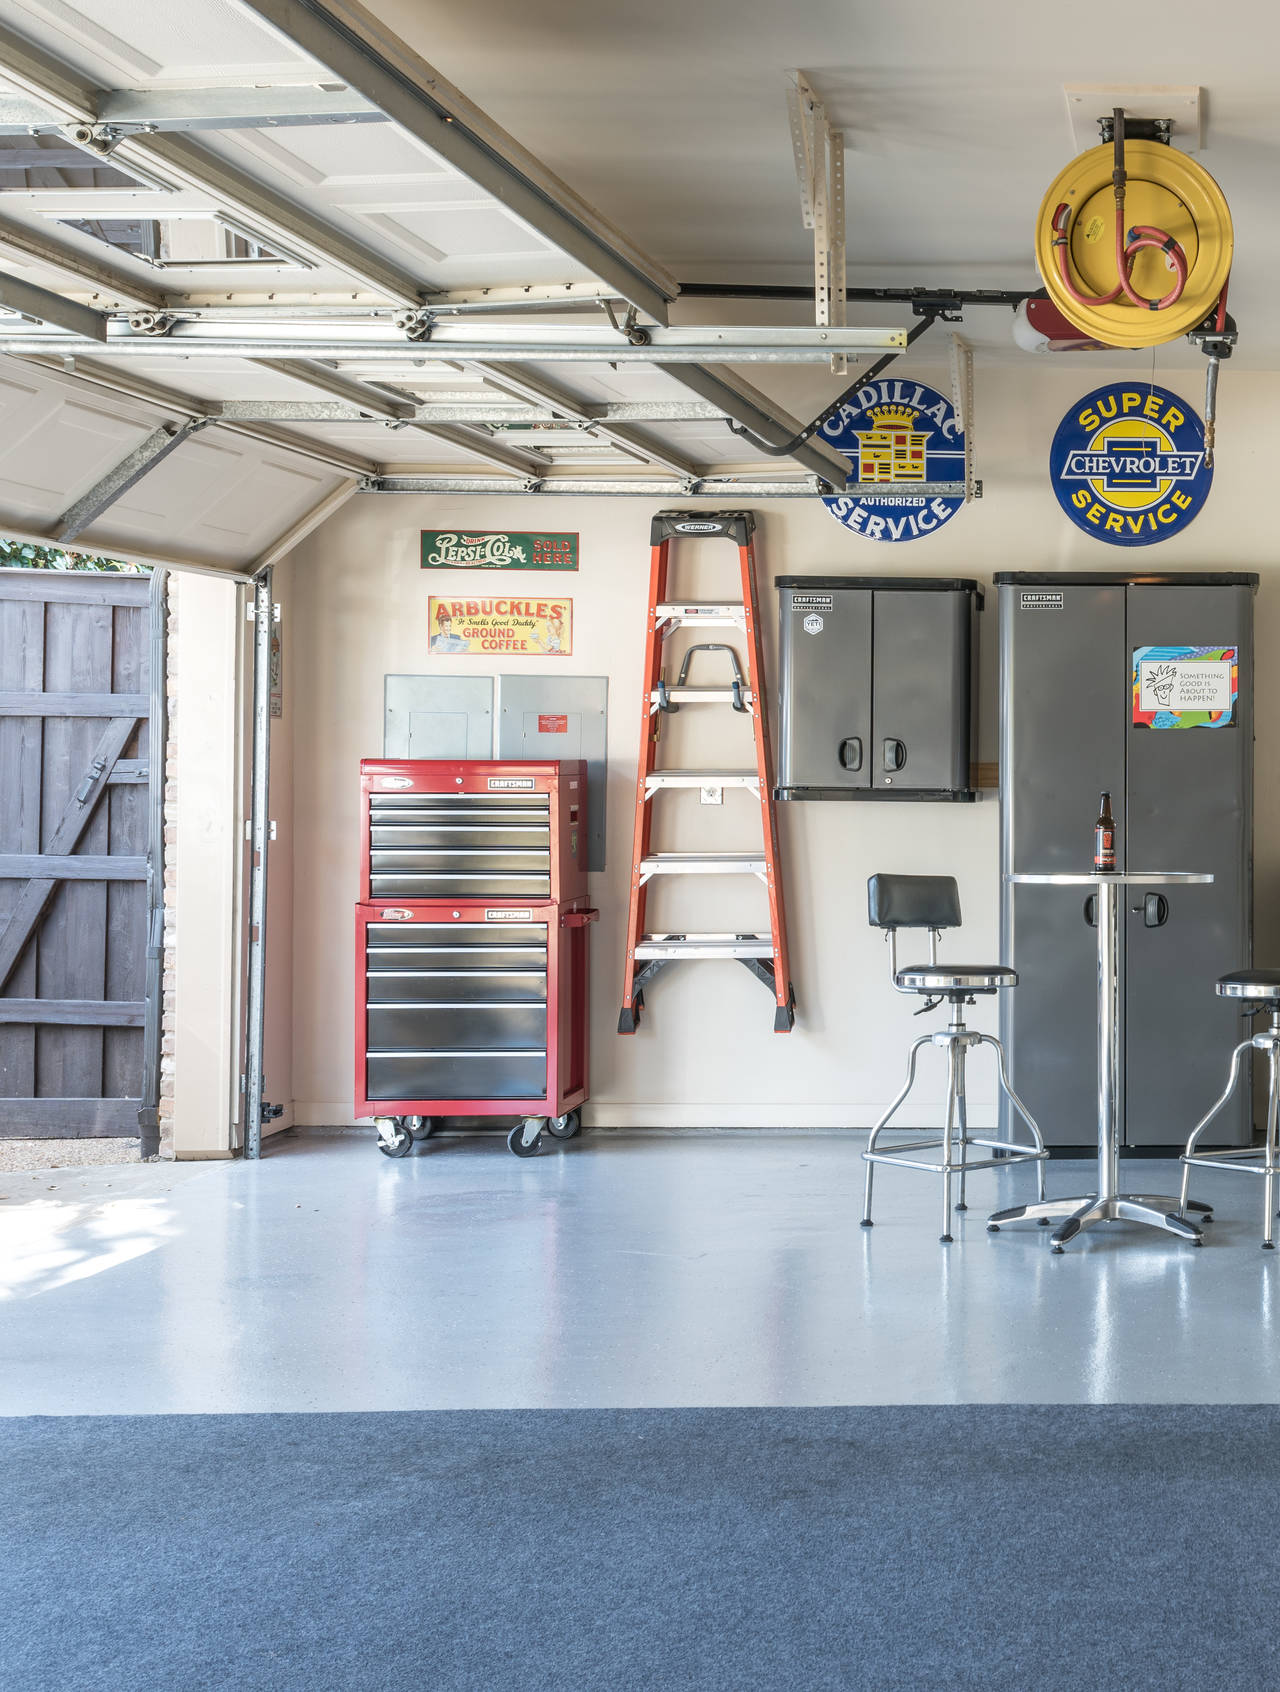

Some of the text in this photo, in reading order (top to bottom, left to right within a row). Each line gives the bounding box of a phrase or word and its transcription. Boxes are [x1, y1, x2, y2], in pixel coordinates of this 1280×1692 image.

[1078, 392, 1185, 432] SUPER
[1070, 456, 1196, 474] CHEVROLET
[859, 497, 926, 506] AUTHORIZED
[1071, 490, 1192, 534] SERVICE
[832, 497, 952, 540] SERVICE
[533, 540, 571, 552] SOLD
[532, 552, 573, 564] HERE
[466, 618, 489, 626] Smells
[490, 618, 509, 628] Good
[462, 628, 515, 638] GROUND
[481, 640, 528, 650] COFFEE
